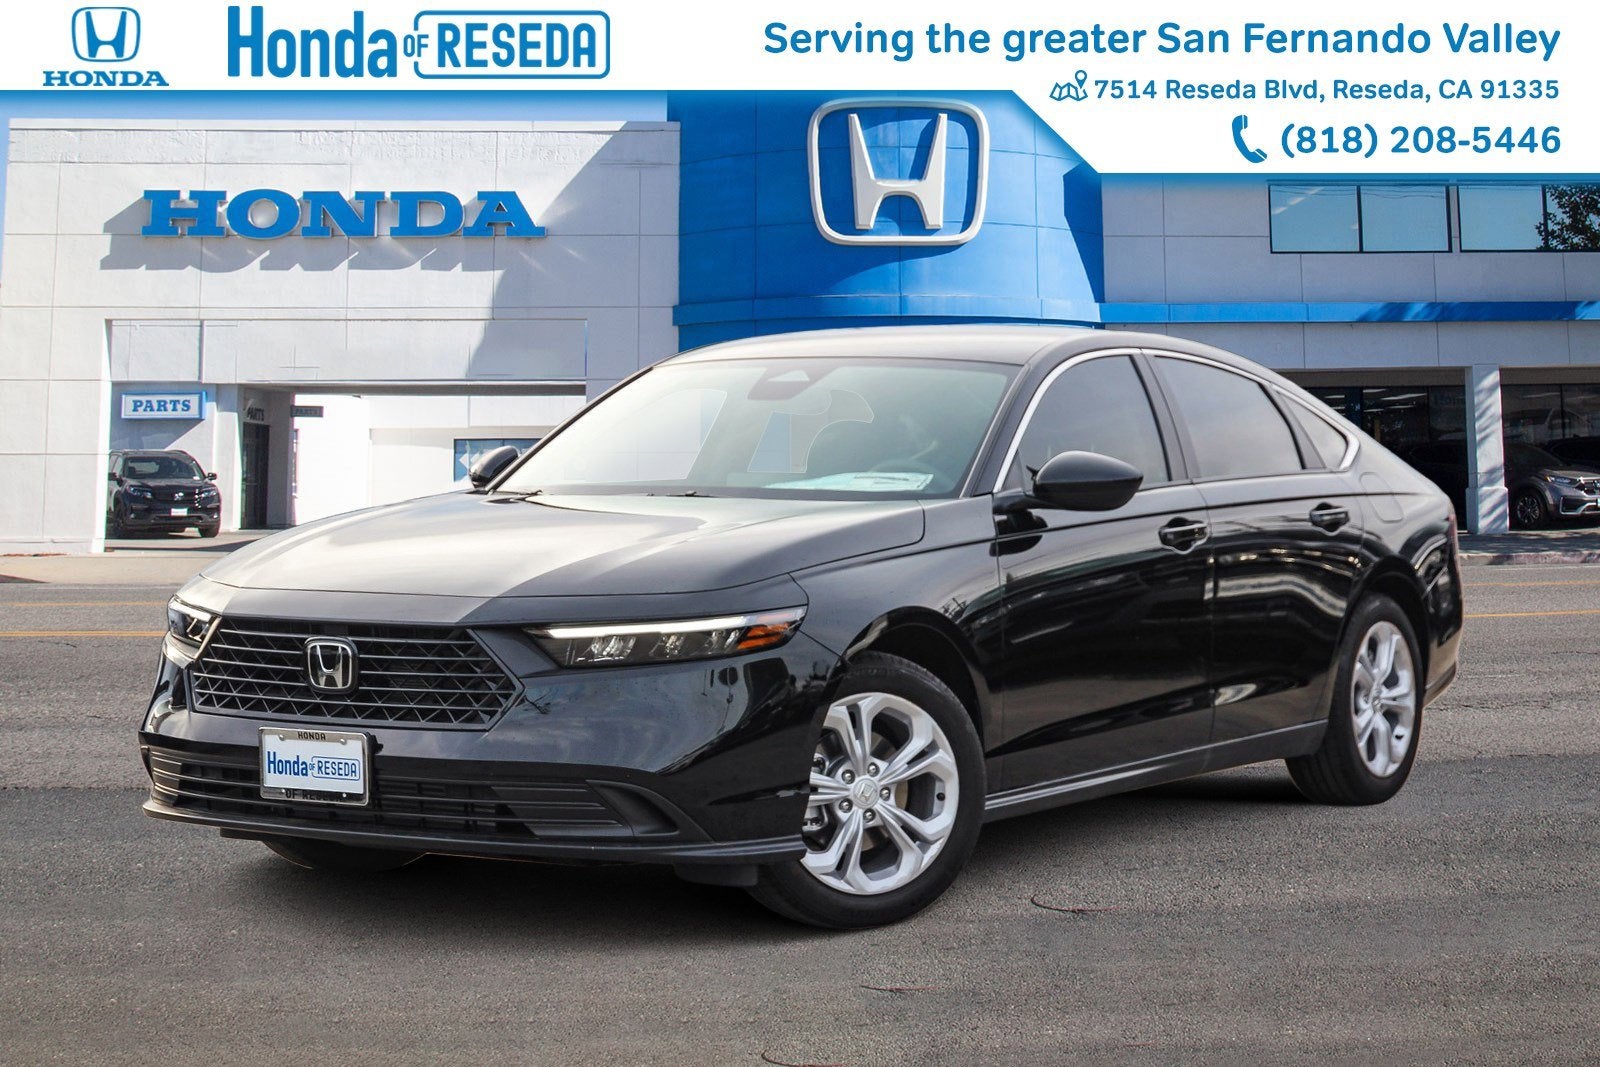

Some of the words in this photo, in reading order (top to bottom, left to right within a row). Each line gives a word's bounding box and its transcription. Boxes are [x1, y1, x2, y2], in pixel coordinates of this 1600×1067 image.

[142, 188, 547, 240] HONDA
[131, 399, 192, 413] PARTS
[297, 731, 326, 741] HONDA
[267, 751, 309, 777] Honda
[309, 763, 316, 771] OF
[318, 760, 357, 777] RESEDA
